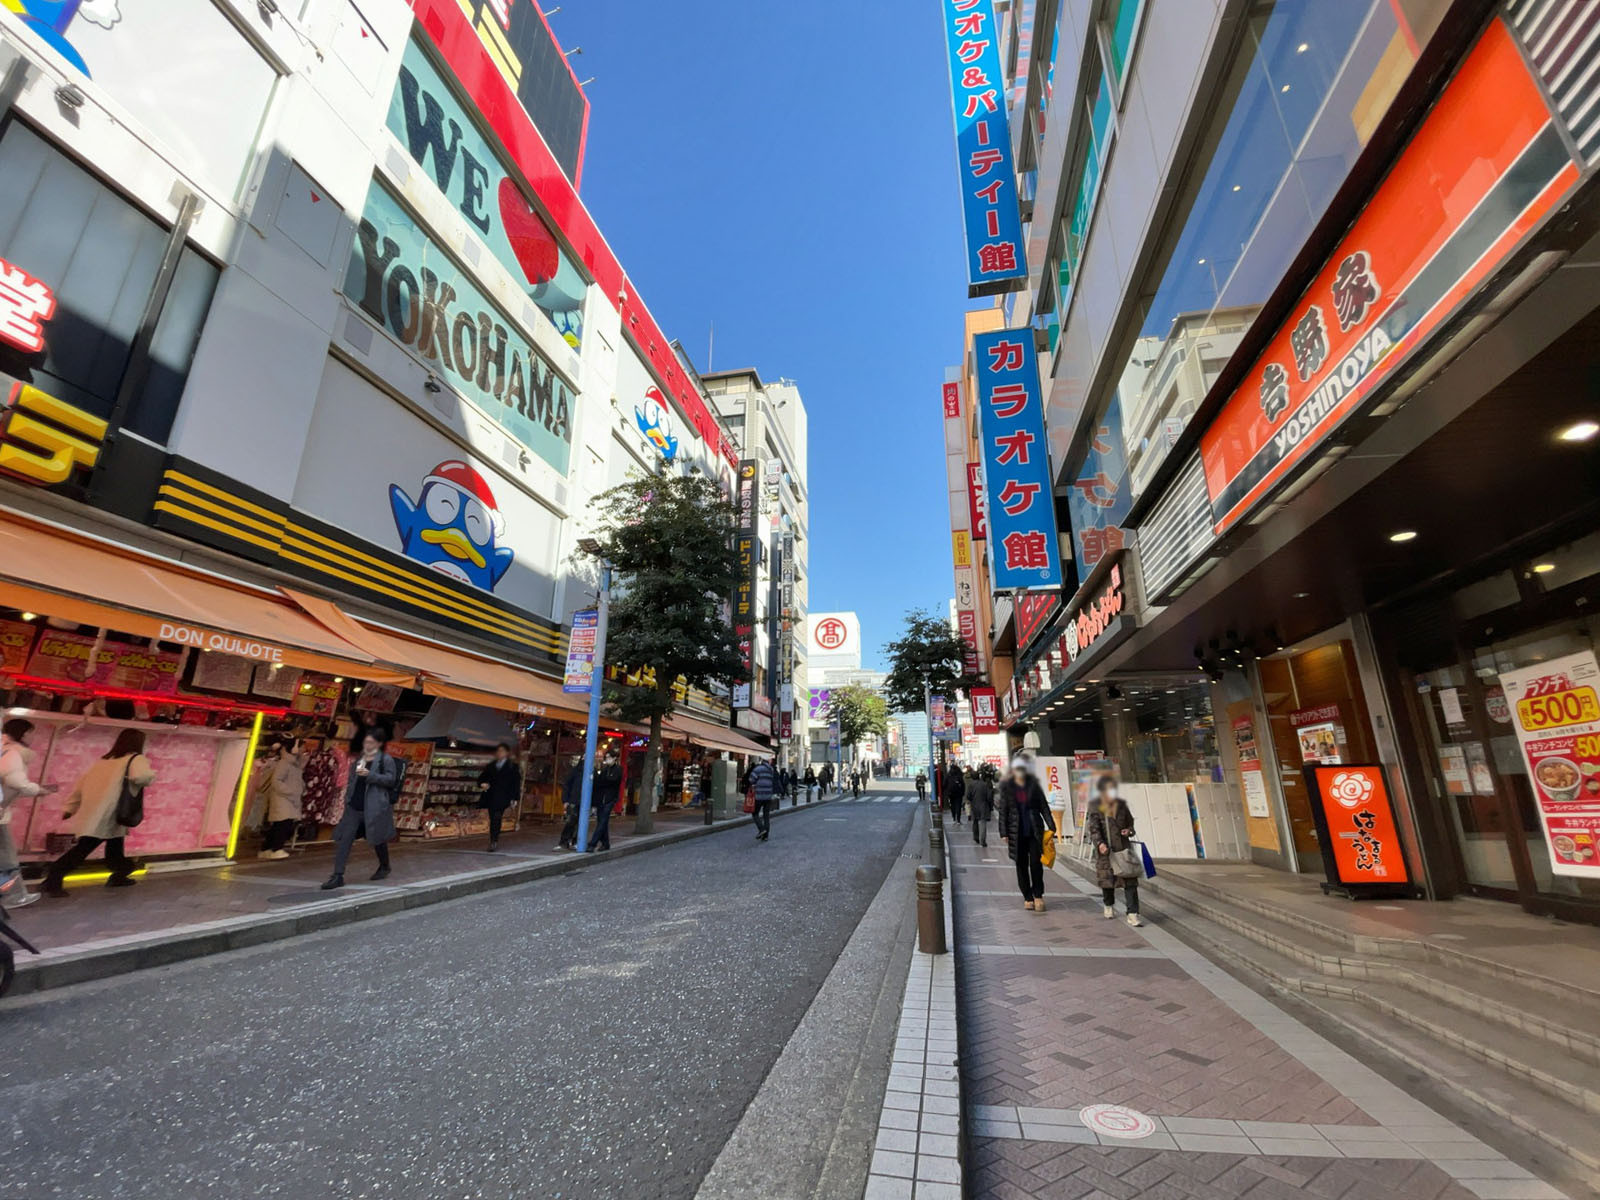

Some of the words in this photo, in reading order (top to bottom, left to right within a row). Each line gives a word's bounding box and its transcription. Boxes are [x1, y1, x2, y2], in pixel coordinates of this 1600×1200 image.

[399, 64, 491, 236] WE
[358, 216, 572, 445] YOKOHAMA
[1273, 326, 1391, 458] YOSHINOYA
[988, 340, 1050, 571] カラオケ館
[159, 623, 204, 646] DON
[208, 634, 284, 663] QUIJOTE
[975, 718, 997, 727] KFC
[1525, 676, 1565, 697] ランチ
[1577, 736, 1600, 757] 50
